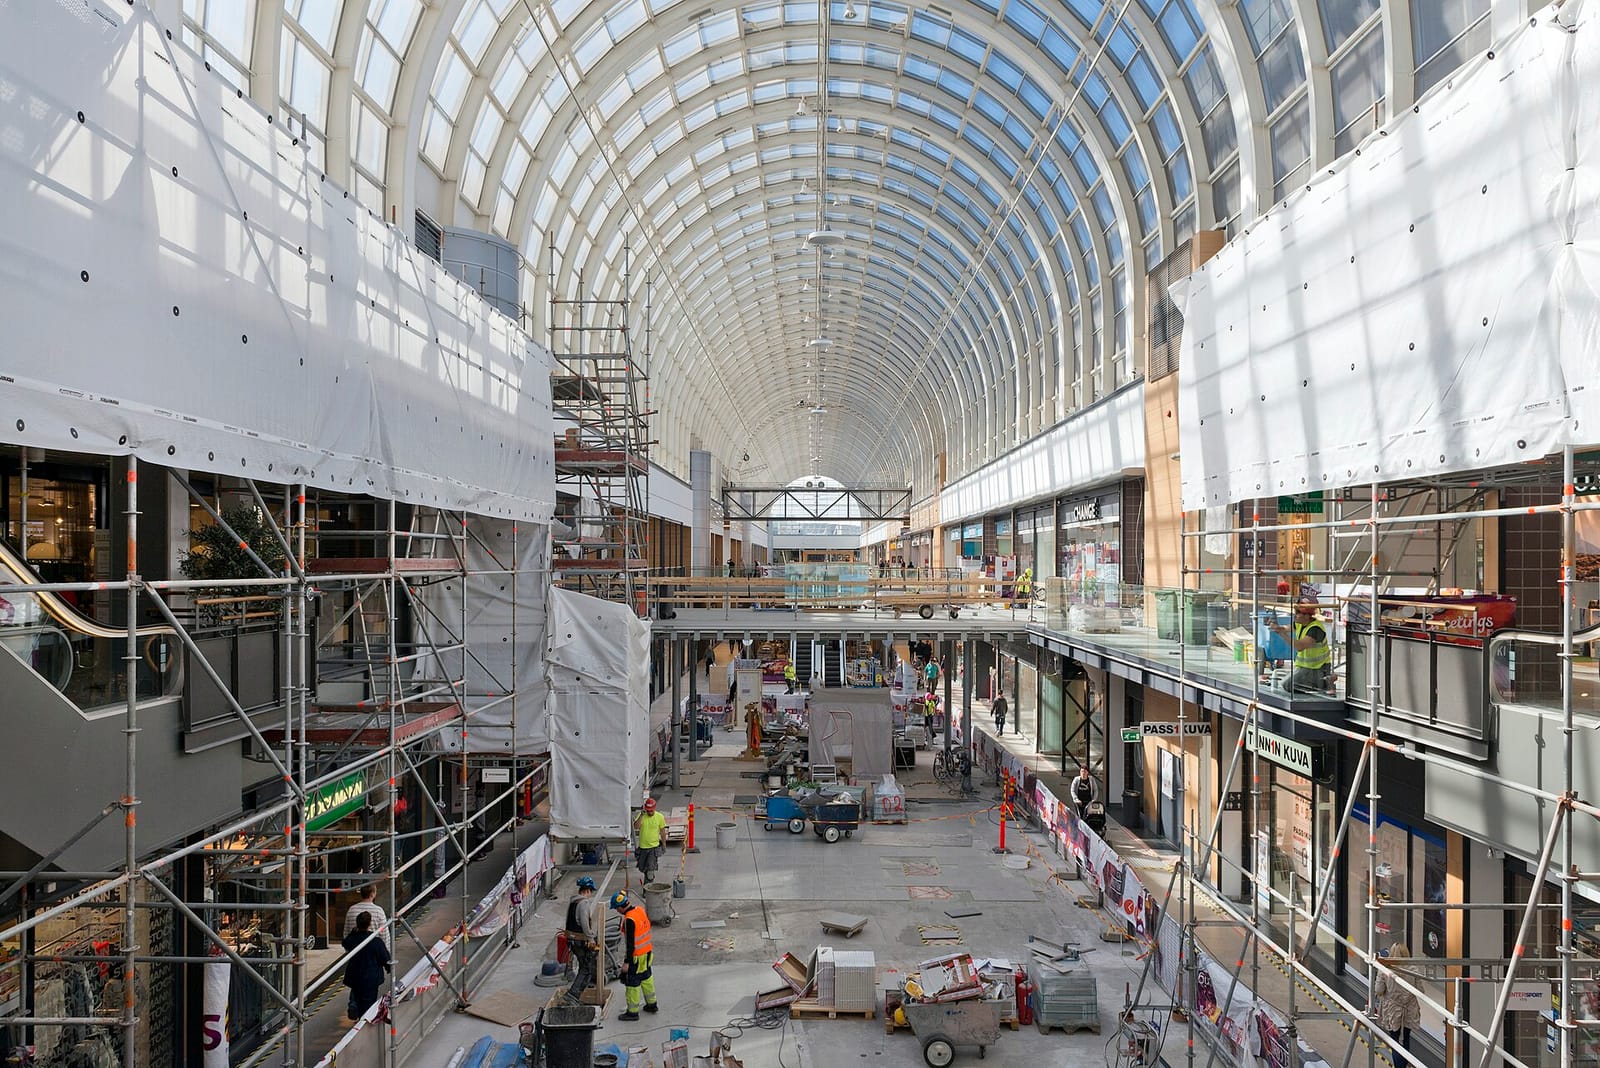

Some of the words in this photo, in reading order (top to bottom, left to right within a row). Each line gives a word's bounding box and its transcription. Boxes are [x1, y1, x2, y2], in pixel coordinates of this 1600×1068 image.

[1248, 730, 1281, 757] TNN1N
[1283, 746, 1311, 769] KUVA
[1510, 991, 1543, 999] NTERSPORT
